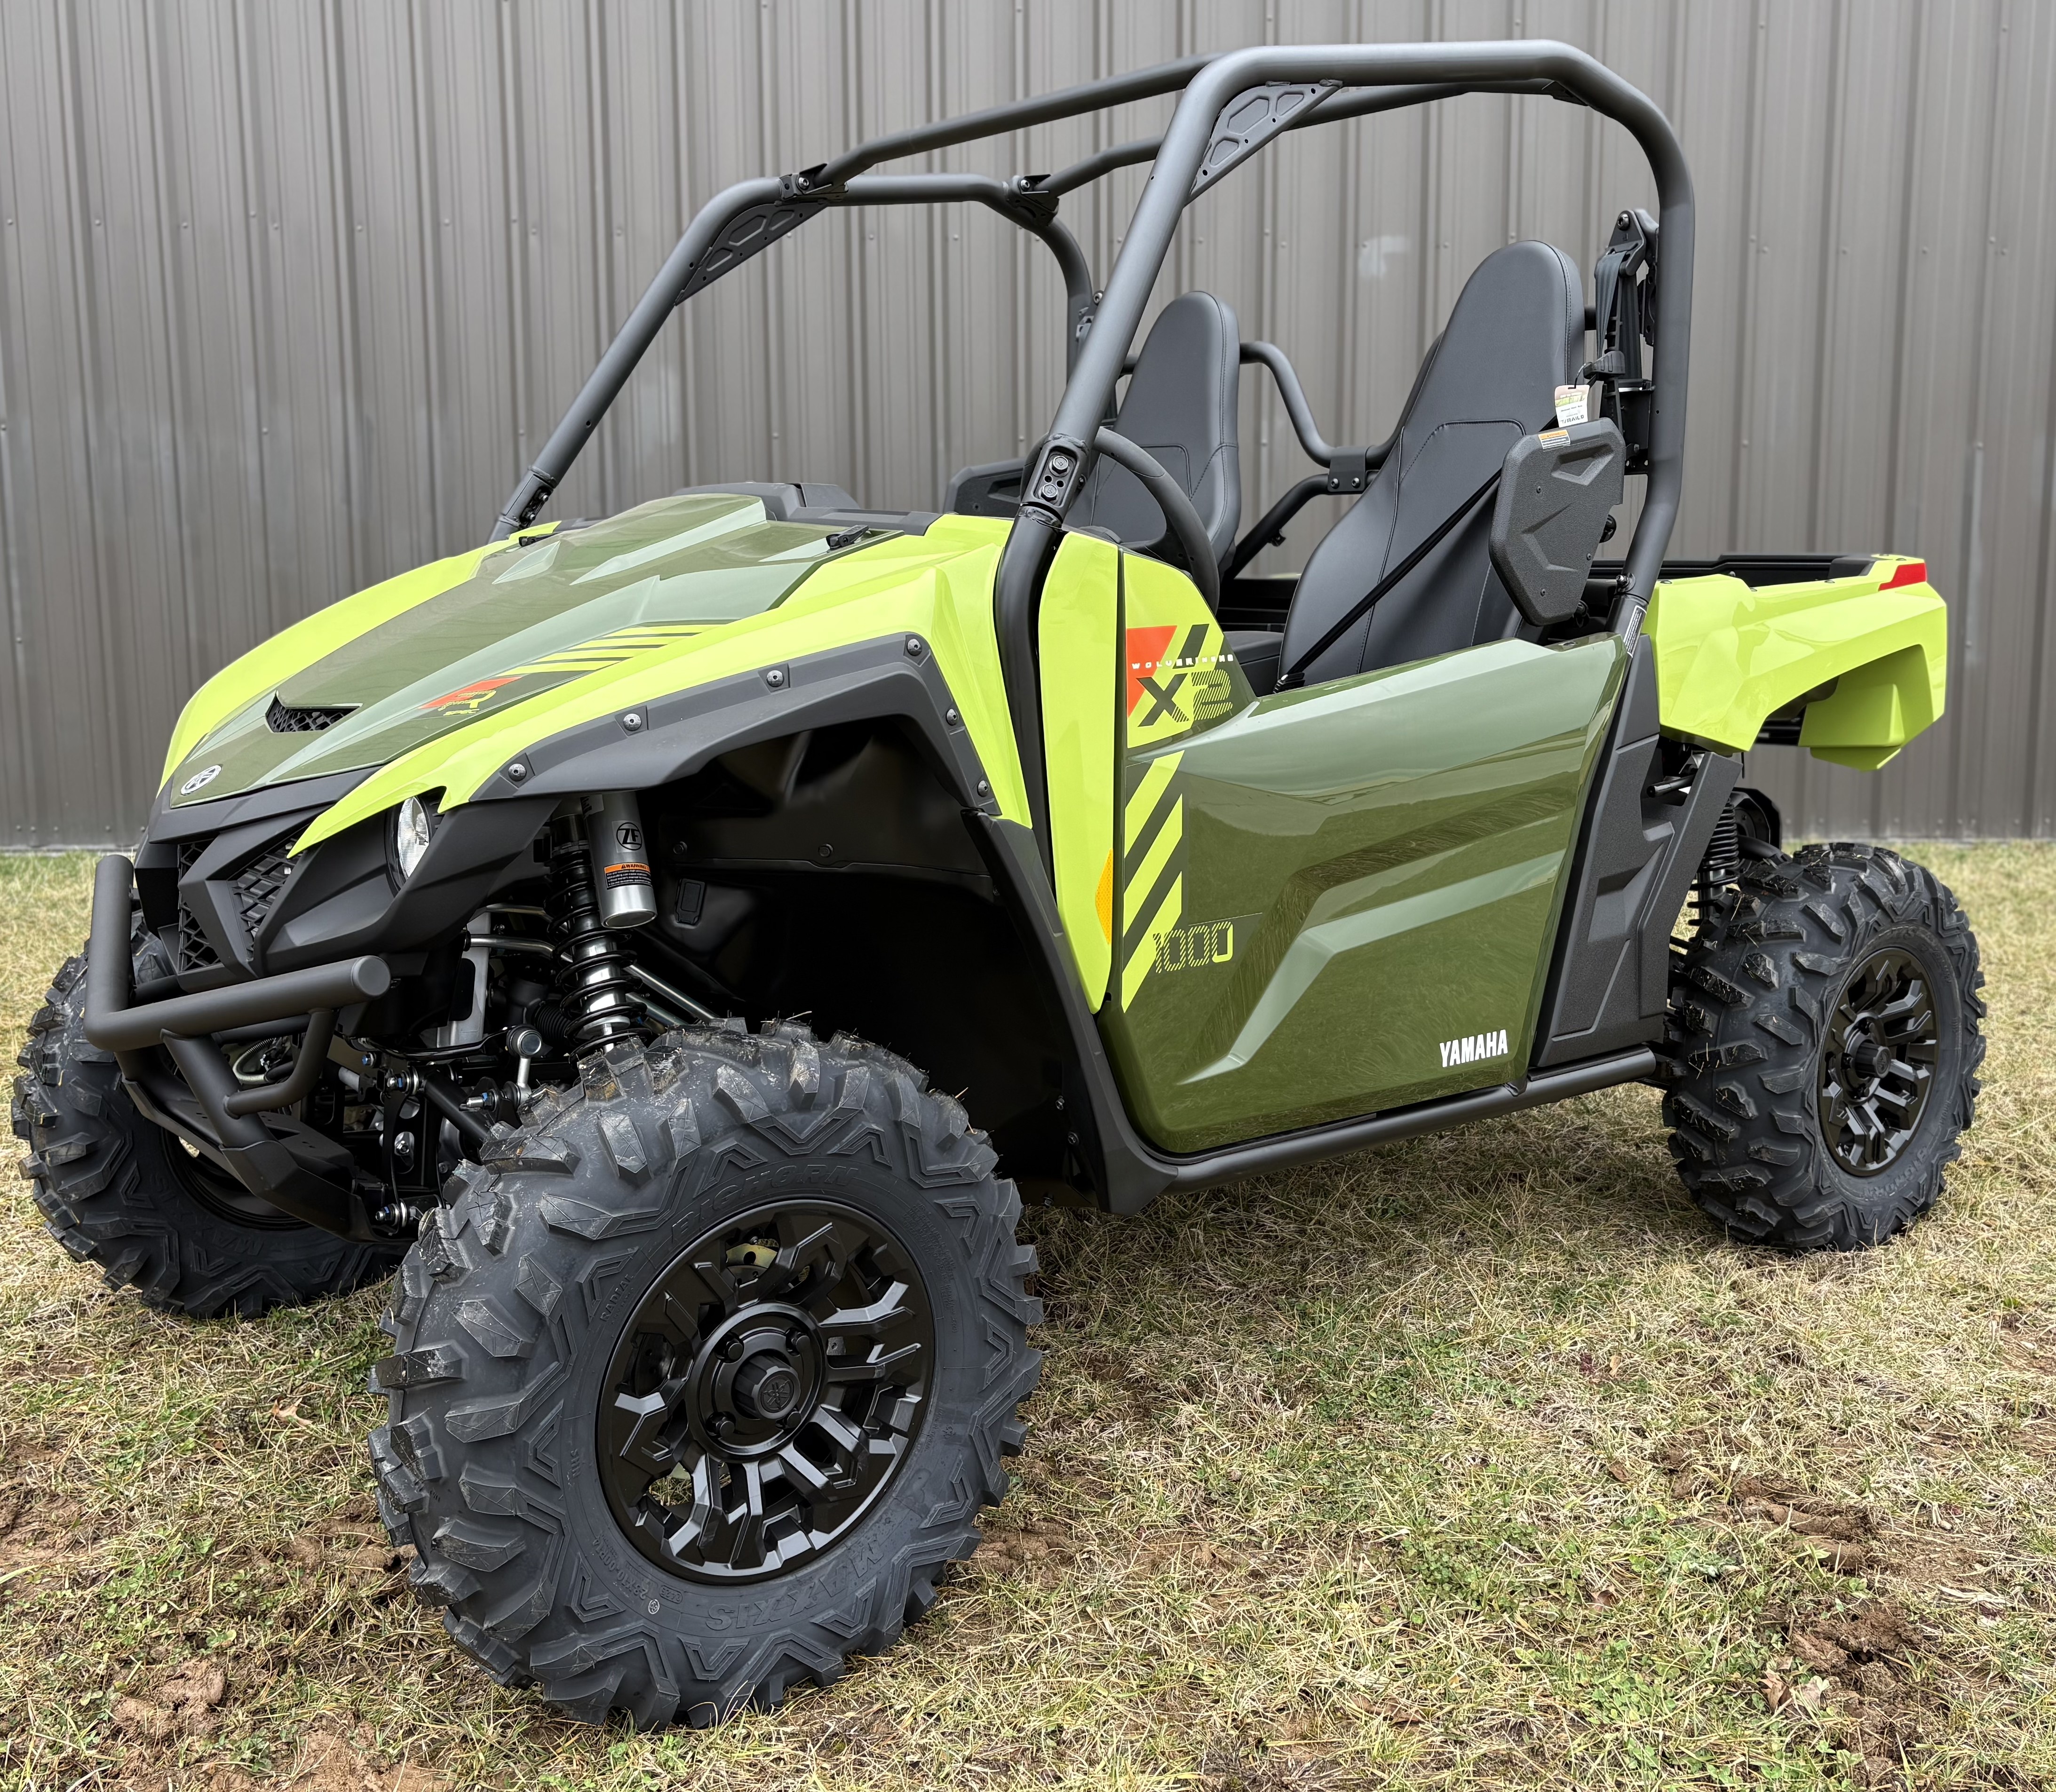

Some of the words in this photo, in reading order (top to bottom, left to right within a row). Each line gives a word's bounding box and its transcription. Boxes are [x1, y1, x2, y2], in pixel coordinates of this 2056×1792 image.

[1136, 669, 1233, 727] X2
[617, 828, 642, 845] ZF
[1152, 921, 1233, 974] 1000
[1439, 1029, 1508, 1068] YAMAHA
[671, 1163, 859, 1244] BIGHORN
[600, 1273, 634, 1322] RADIAL
[706, 1533, 885, 1631] MAXXIS
